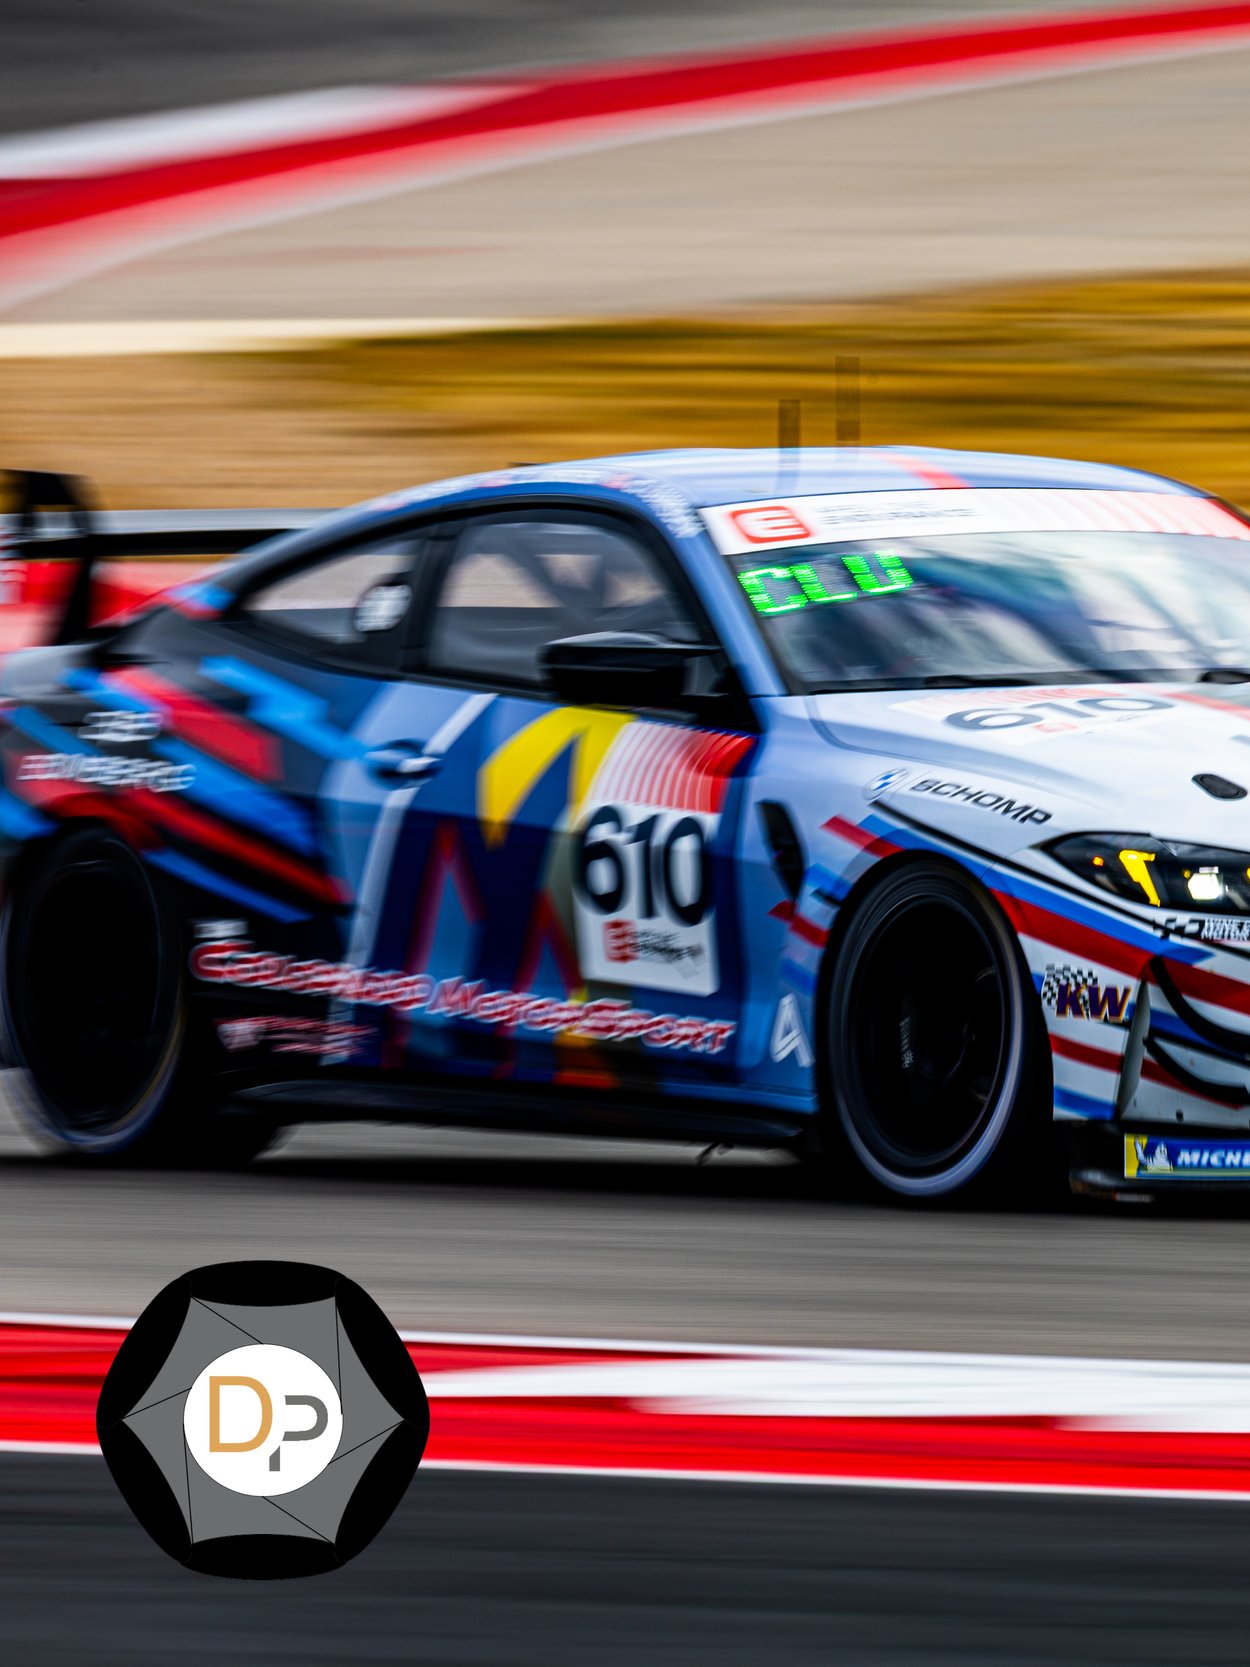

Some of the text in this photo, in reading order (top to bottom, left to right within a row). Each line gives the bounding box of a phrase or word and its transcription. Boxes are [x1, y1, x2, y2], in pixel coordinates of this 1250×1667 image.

[945, 697, 1176, 731] 610
[909, 778, 1054, 826] SCHOMP
[575, 804, 712, 926] 610
[1055, 983, 1131, 1023] KW
